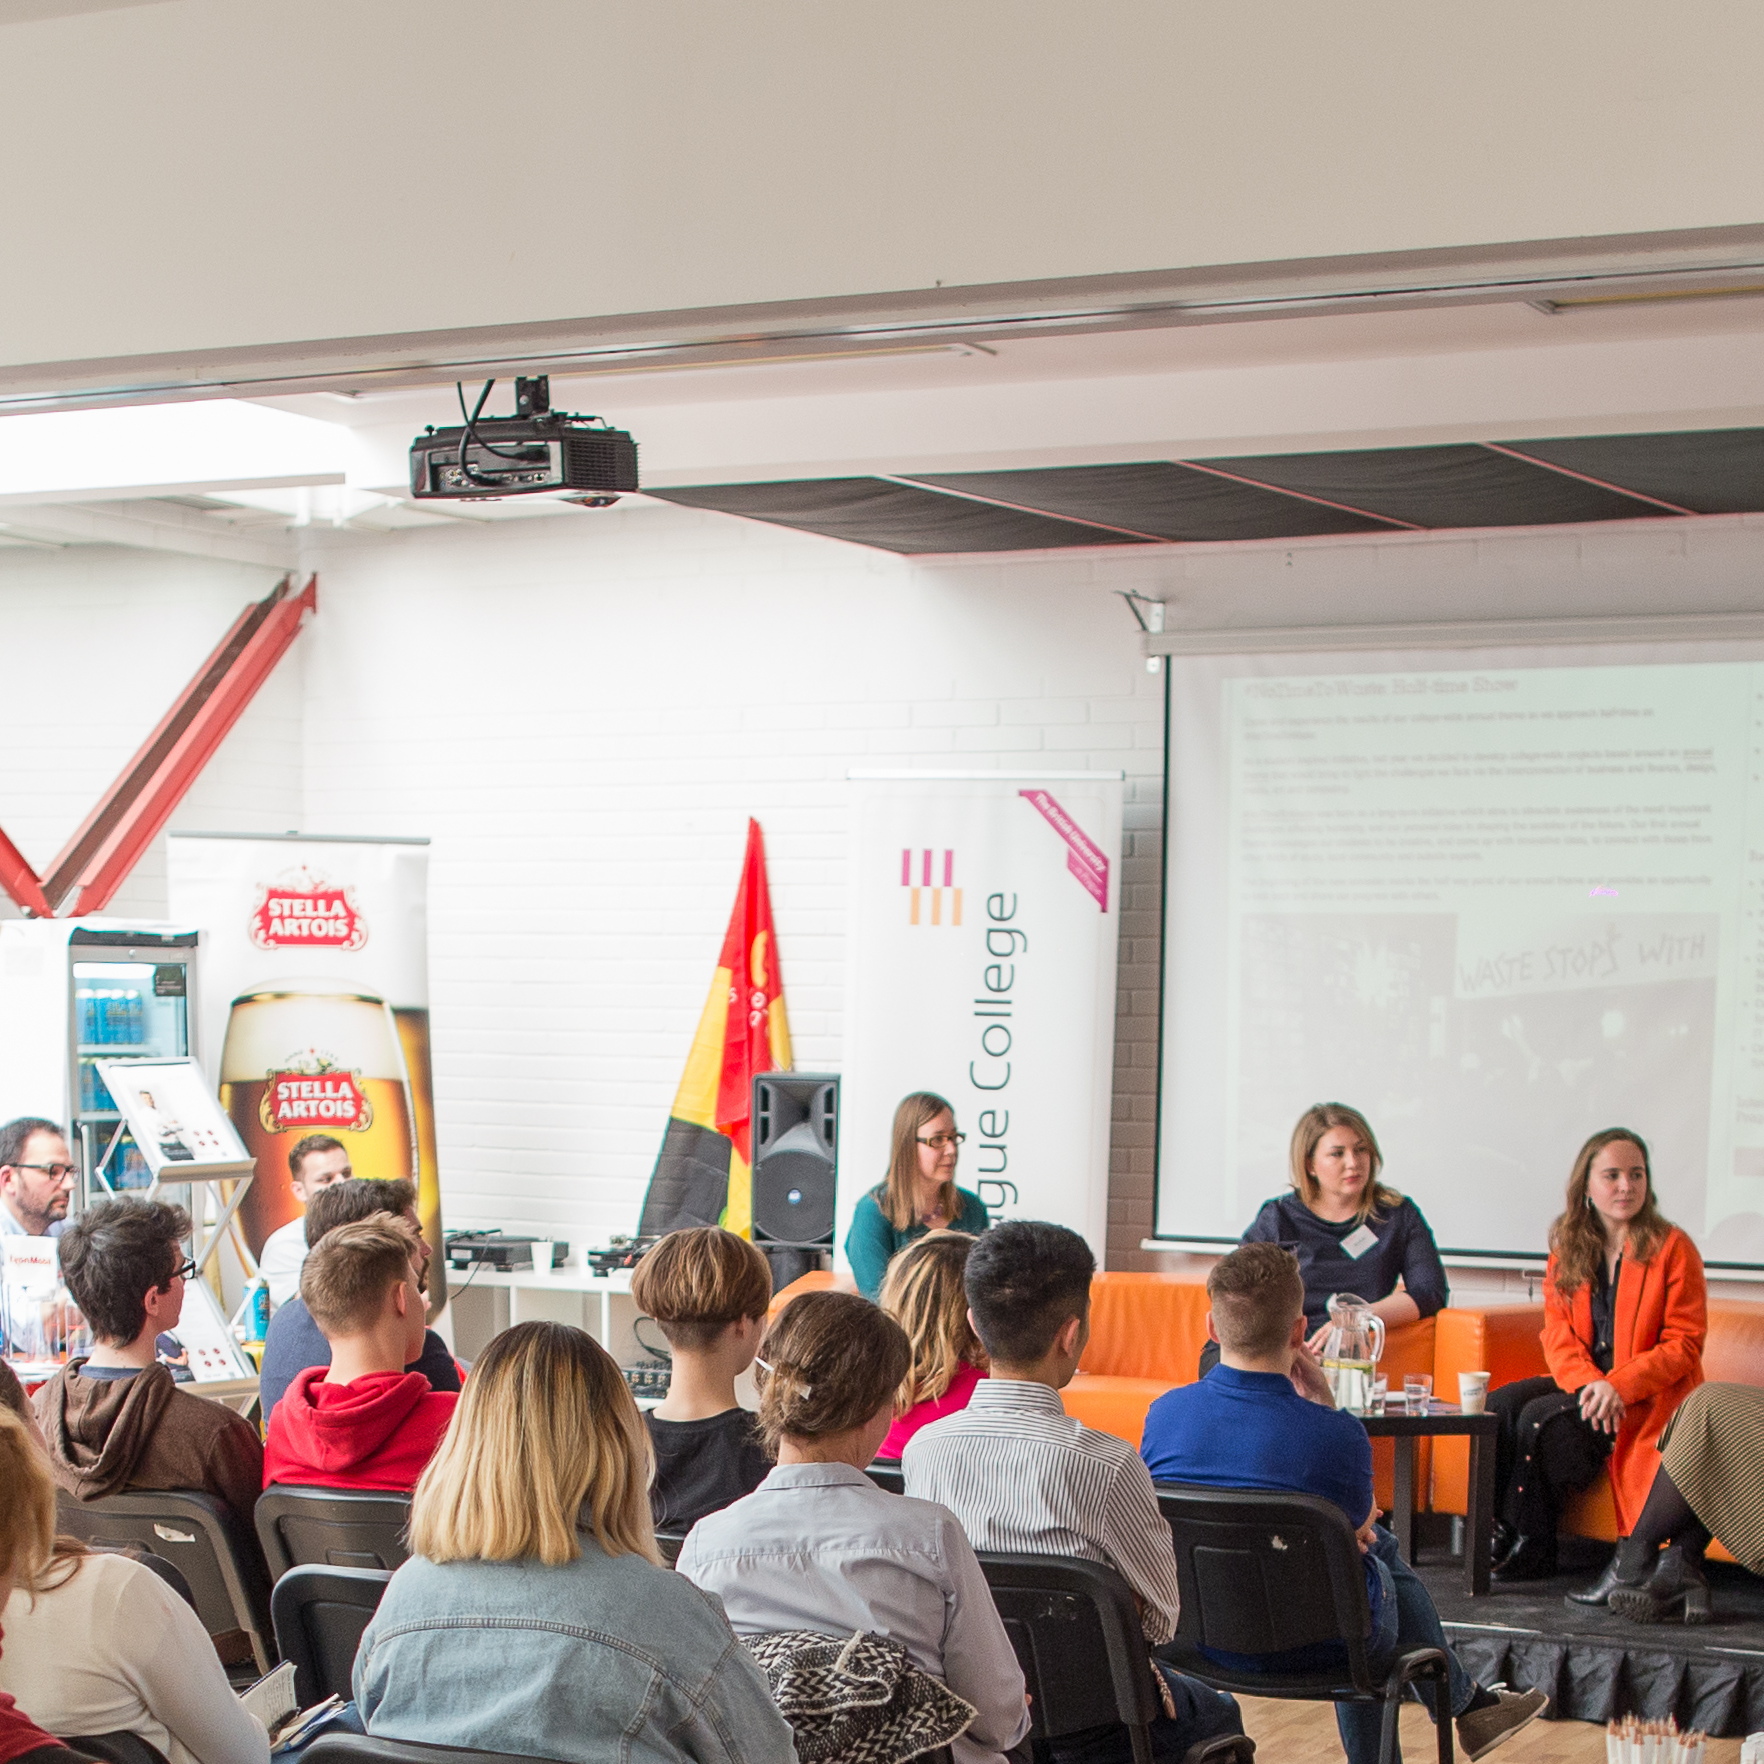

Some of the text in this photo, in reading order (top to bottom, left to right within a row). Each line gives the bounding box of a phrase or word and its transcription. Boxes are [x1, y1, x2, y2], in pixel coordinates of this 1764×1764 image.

[267, 898, 347, 918] STELLA
[268, 918, 349, 938] ARTOIS
[1638, 931, 1705, 966] WITH
[969, 892, 1027, 1091] College
[277, 1081, 354, 1101] STELLA
[278, 1100, 356, 1119] ARTOIS
